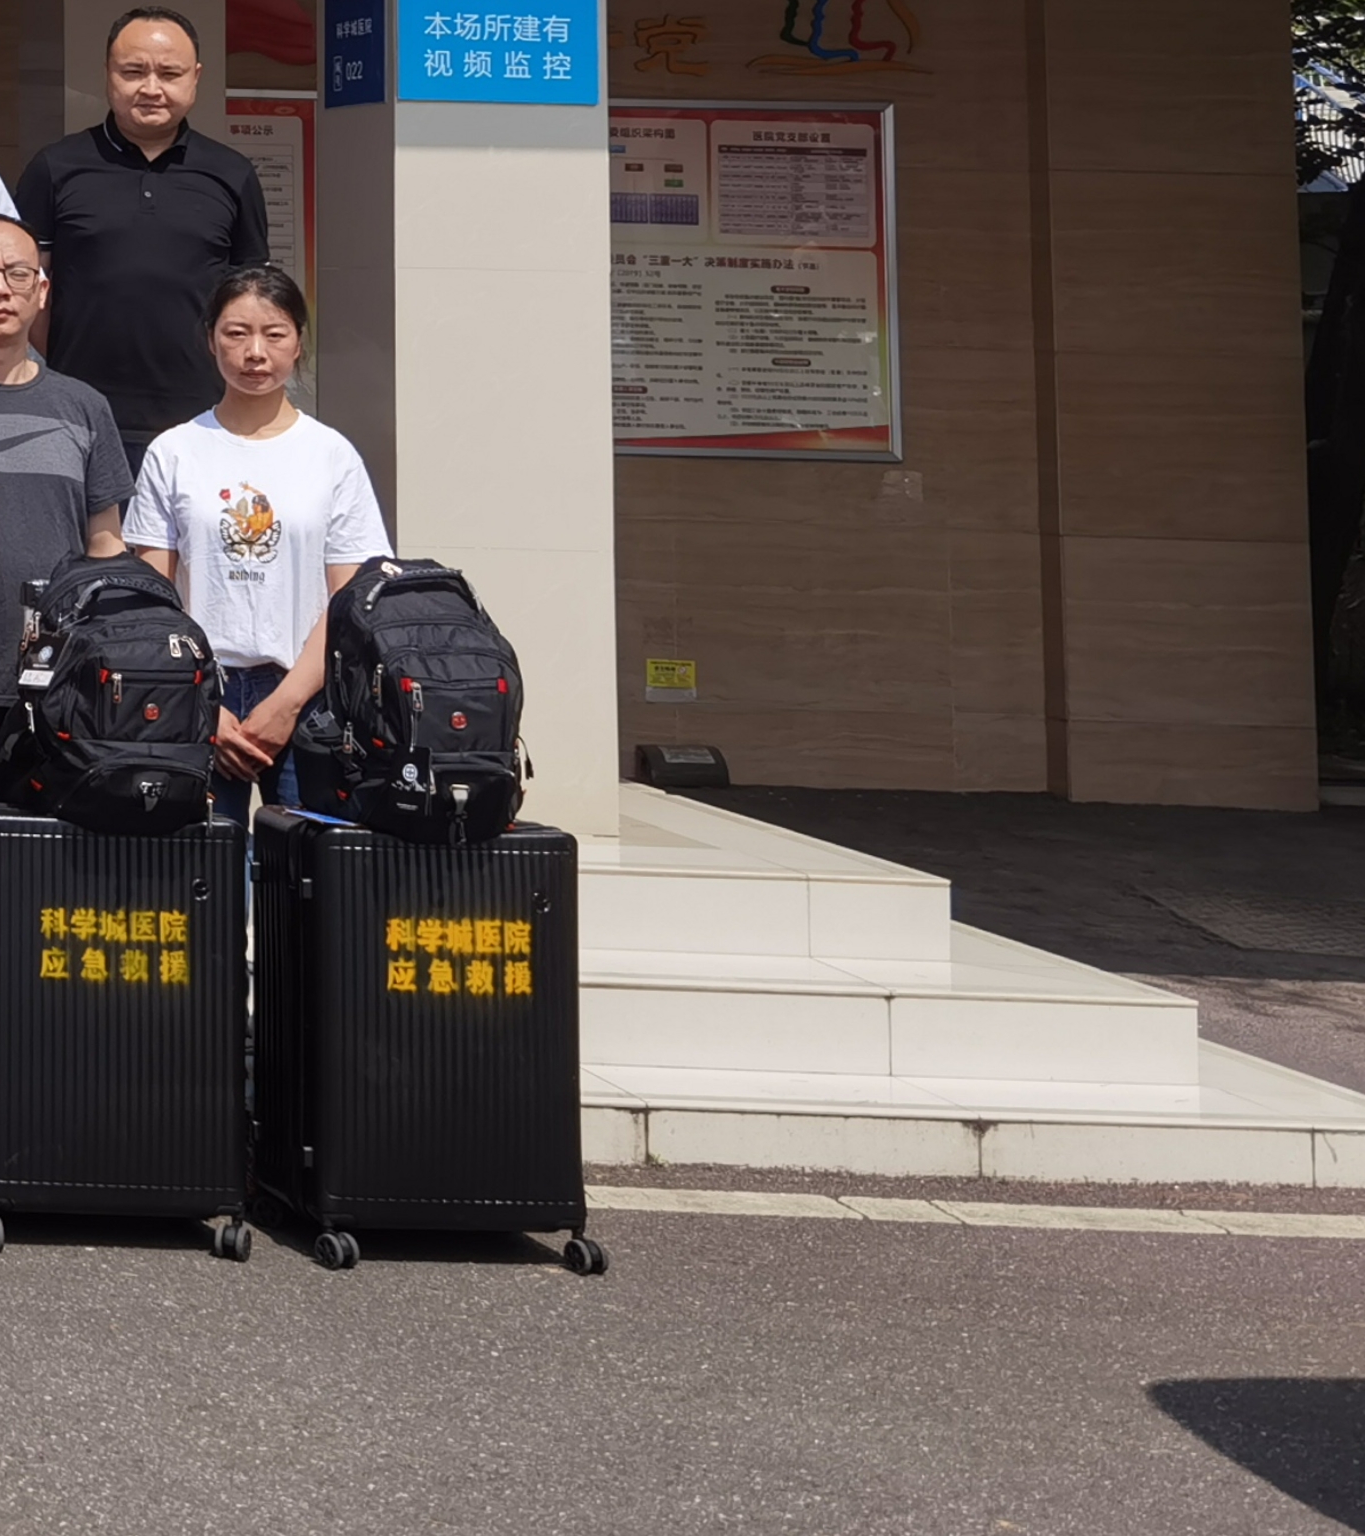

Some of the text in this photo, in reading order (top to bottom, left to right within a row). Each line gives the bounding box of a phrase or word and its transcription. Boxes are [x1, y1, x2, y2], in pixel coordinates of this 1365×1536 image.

[336, 17, 372, 39] 科学城医院
[424, 11, 571, 43] 本场所建有
[610, 13, 709, 77] 党
[345, 60, 363, 81] 022
[424, 49, 572, 79] 视频监控
[230, 124, 274, 136] 事项公示
[751, 130, 831, 144] 医院党支部设置
[228, 568, 266, 585] nothing
[39, 907, 189, 944] 科学城医院
[385, 915, 534, 954] 科学城医院
[39, 946, 190, 985] 应急救援
[385, 957, 534, 998] 应急救援
